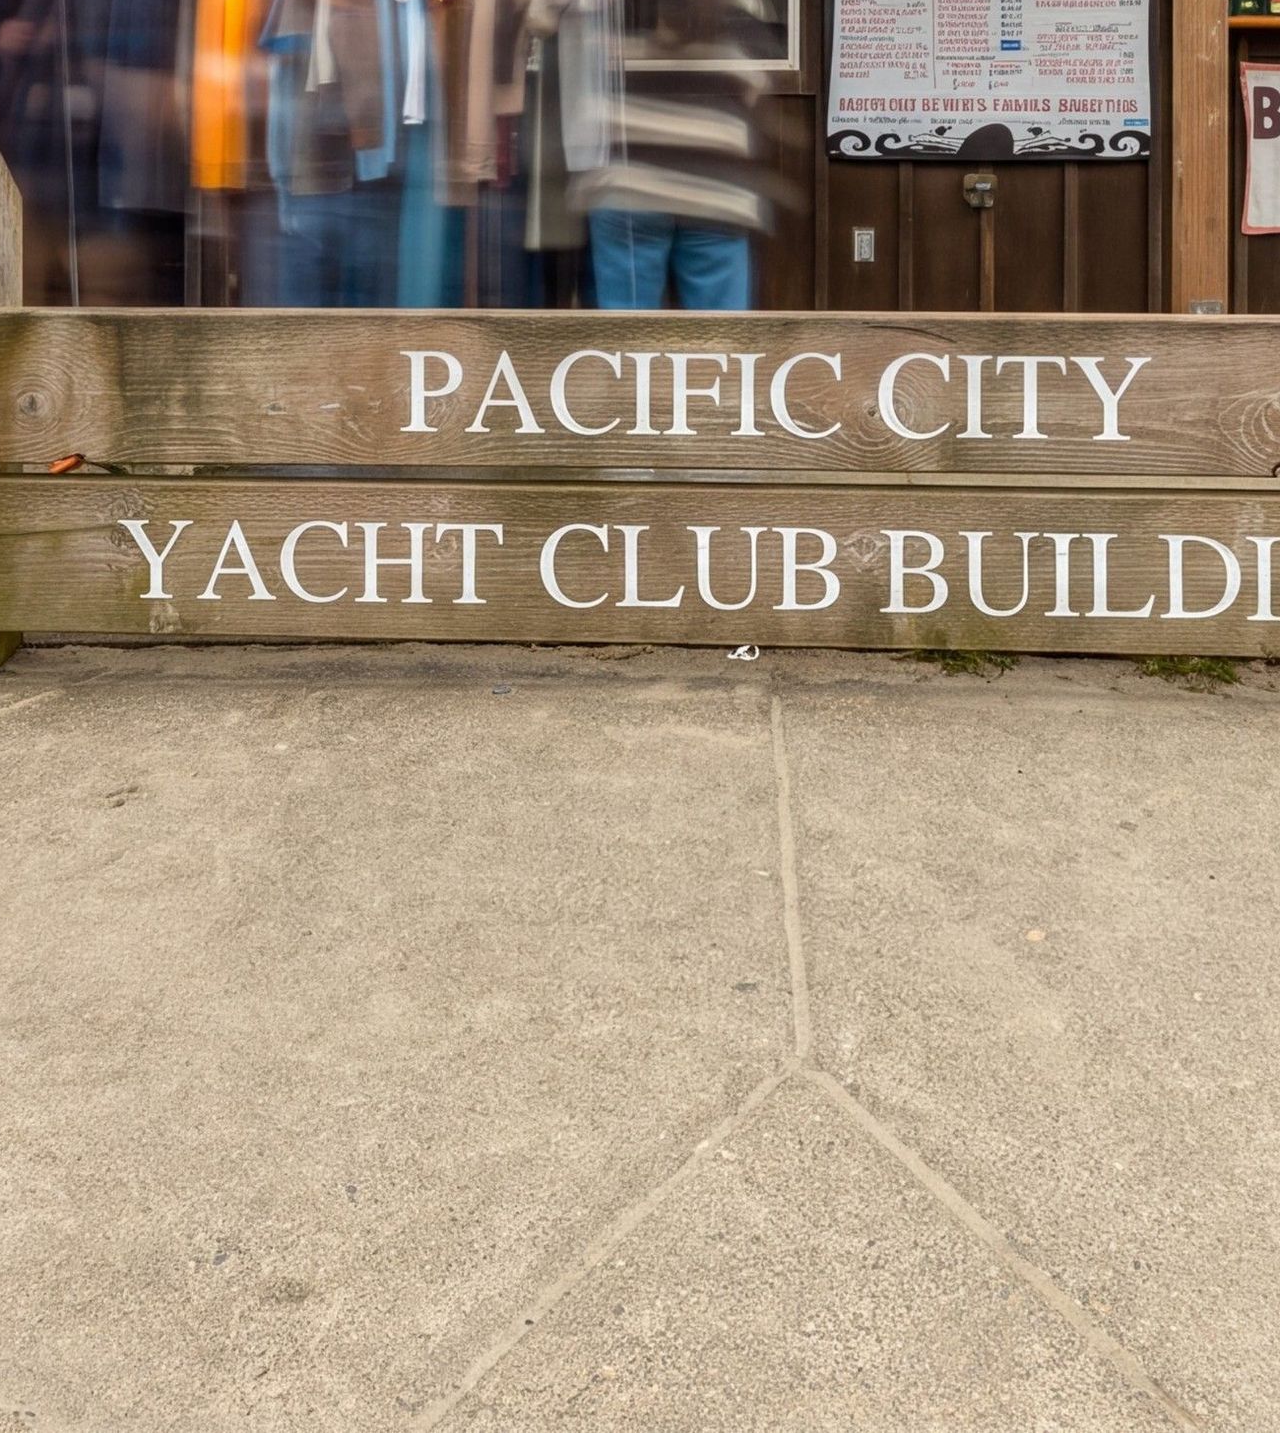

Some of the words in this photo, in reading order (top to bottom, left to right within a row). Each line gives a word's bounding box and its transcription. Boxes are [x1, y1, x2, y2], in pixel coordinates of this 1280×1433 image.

[399, 349, 842, 440] PACIFIC
[877, 352, 1151, 441] CITY
[117, 518, 504, 604] YACHT
[539, 522, 841, 612] CLUB
